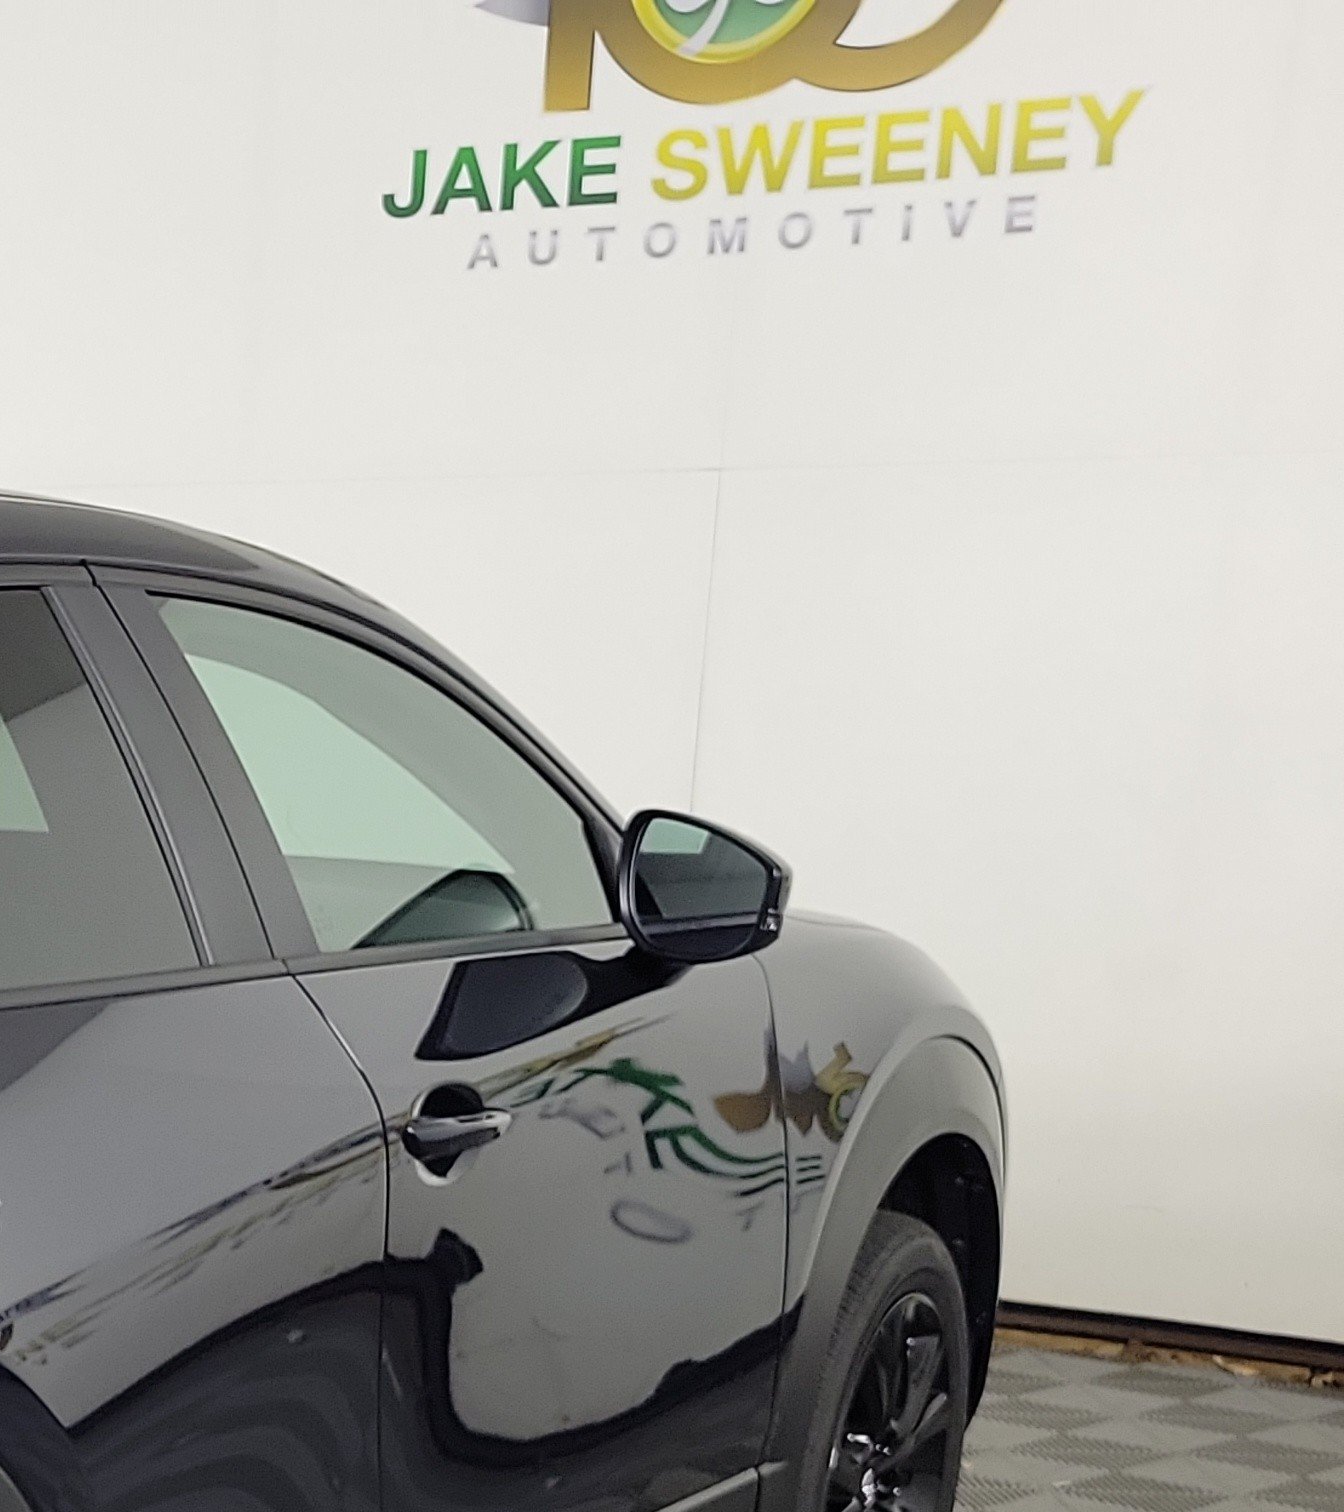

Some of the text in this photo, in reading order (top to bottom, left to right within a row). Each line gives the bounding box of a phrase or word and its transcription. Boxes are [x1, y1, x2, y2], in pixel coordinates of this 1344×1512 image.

[380, 88, 1147, 219] JAKE SWEENEY
[466, 195, 1037, 270] AUTOMOTIVE
